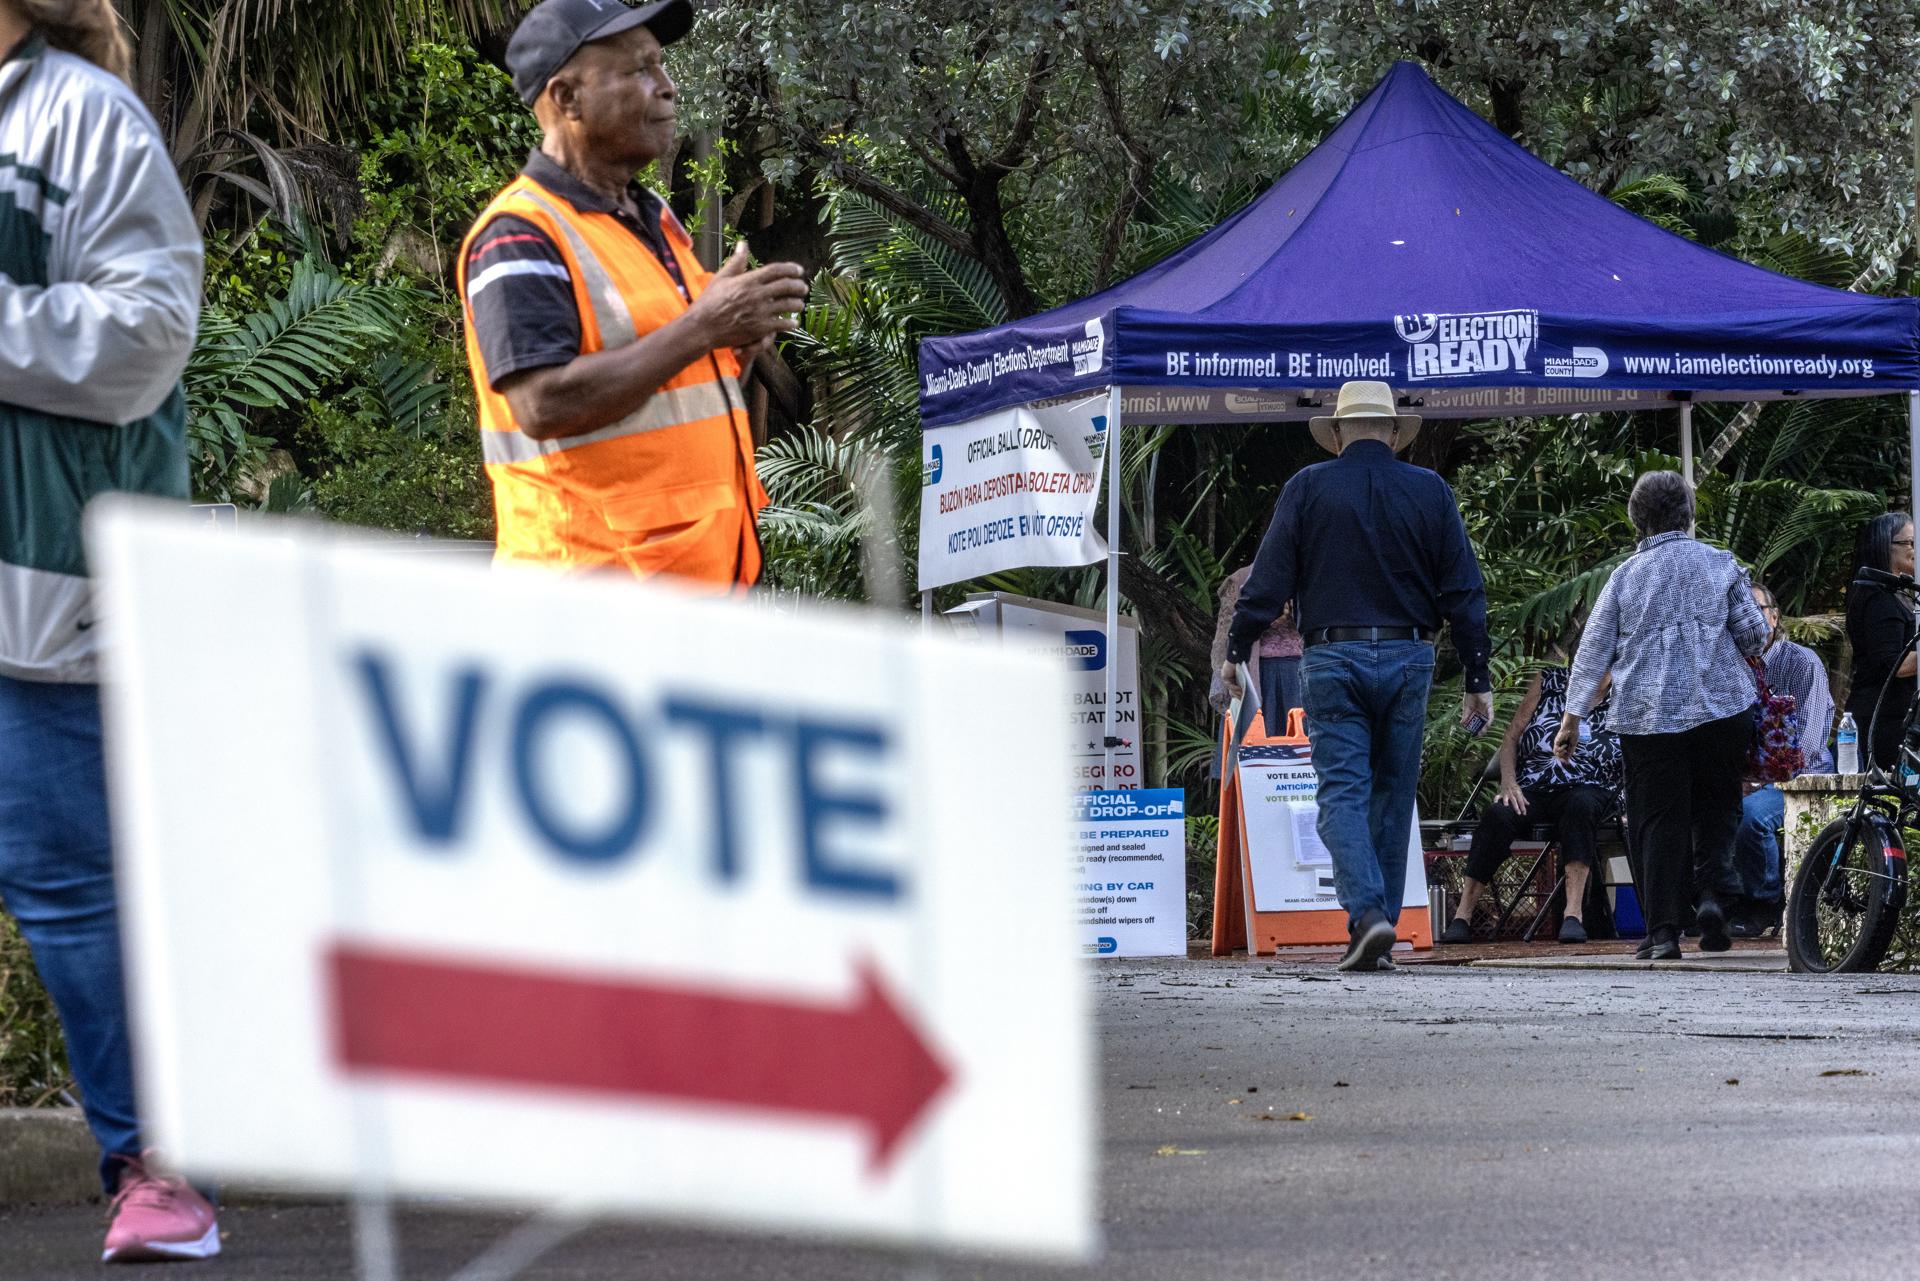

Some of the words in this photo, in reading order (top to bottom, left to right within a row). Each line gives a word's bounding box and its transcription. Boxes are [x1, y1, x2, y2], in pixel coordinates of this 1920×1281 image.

[1439, 315, 1531, 341] ELECTION
[1414, 338, 1531, 376] READY
[925, 364, 967, 397] Miami-Dade
[967, 357, 993, 386] County
[993, 347, 1028, 377] Elections
[1027, 339, 1069, 373] Department
[1166, 352, 1189, 376] BE
[1195, 353, 1281, 377] informed.
[1288, 353, 1312, 378] BE
[1317, 353, 1396, 377] involved.
[1545, 368, 1573, 376] COUNTY
[1623, 352, 1875, 379] www.iamelectionready.org
[968, 436, 996, 464] OFFICIAL
[964, 483, 983, 508] PARA
[1028, 471, 1070, 494] BOLETA
[948, 530, 967, 555] KOTE
[967, 526, 983, 550] POU
[983, 517, 1016, 545] DEPOZE
[1069, 710, 1135, 724] STATON
[346, 636, 914, 904] VOTE
[1072, 794, 1136, 806] FFICIAL
[1100, 829, 1169, 839] PREPARED
[1106, 843, 1121, 852] and
[1121, 842, 1146, 852] sealed
[1108, 852, 1165, 864] (recommended,
[1106, 882, 1124, 891] BY
[1127, 881, 1155, 891] CAR
[1116, 895, 1137, 903] down
[1097, 905, 1108, 914] off
[1118, 915, 1143, 926] wipers
[1144, 915, 1155, 924] off
